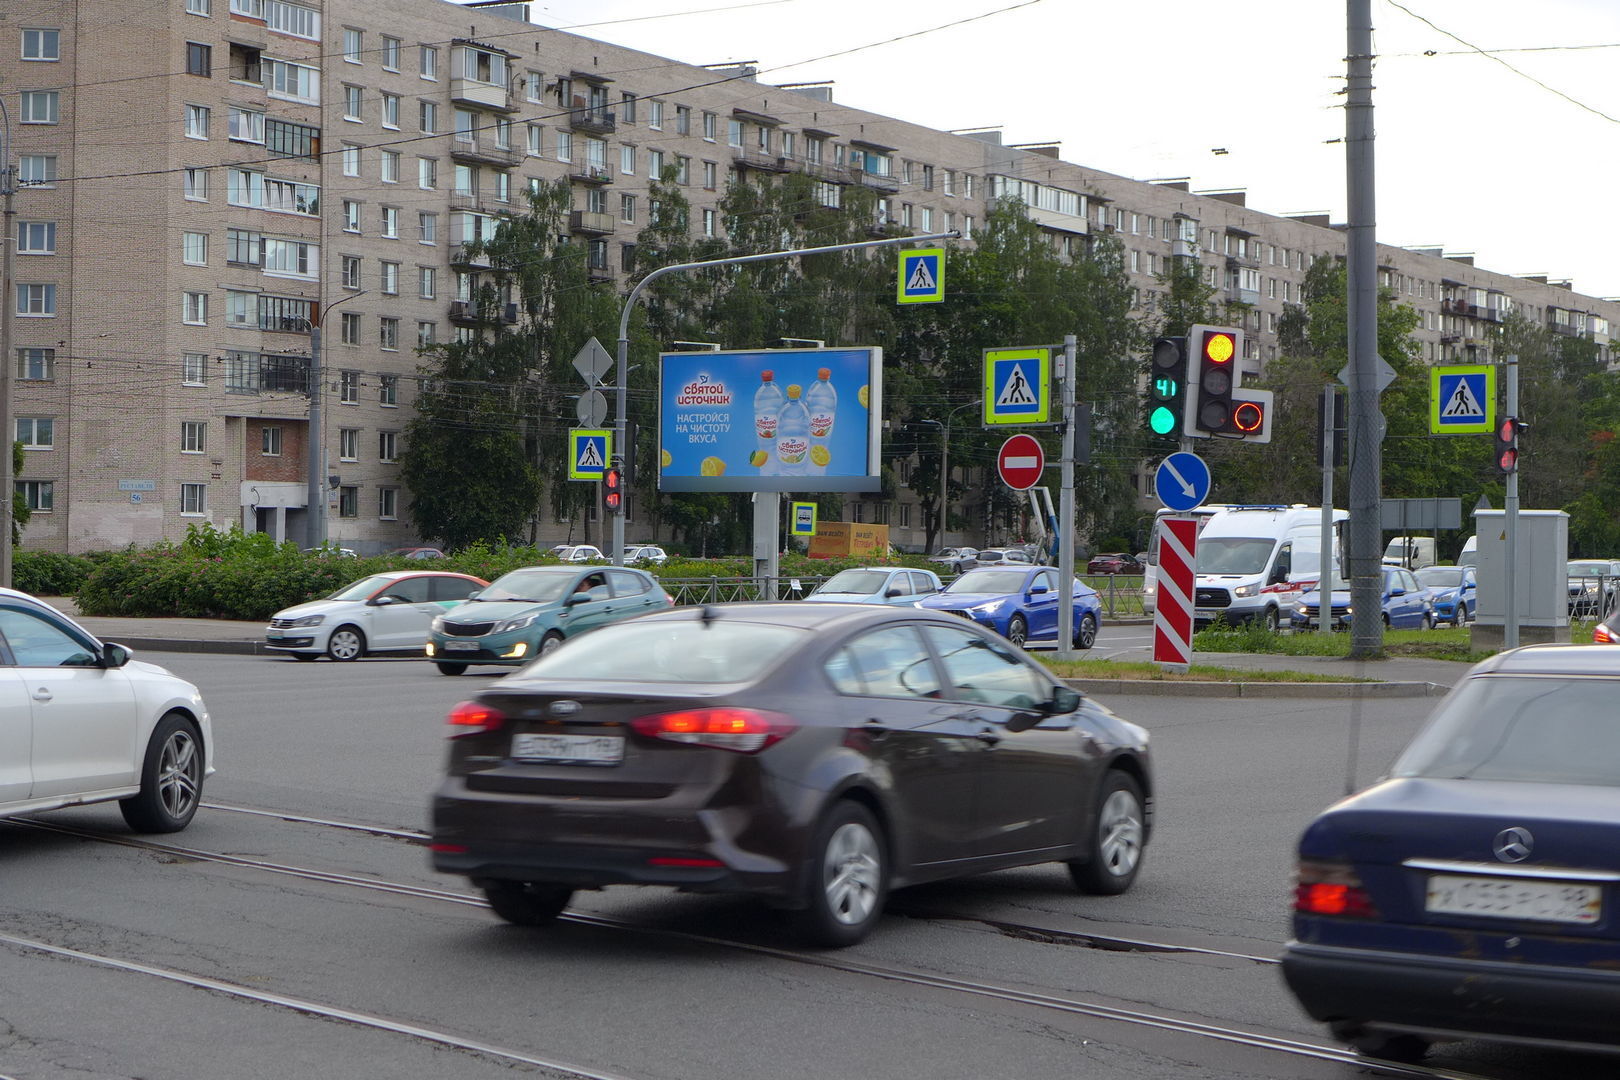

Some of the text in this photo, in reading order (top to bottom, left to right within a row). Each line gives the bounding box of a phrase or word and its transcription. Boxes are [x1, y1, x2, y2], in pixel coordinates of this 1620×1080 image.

[1156, 379, 1176, 397] 41
[676, 412, 729, 423] НАСТРОЙСЯ
[675, 423, 731, 433] НА ЧИСТОТУ
[688, 434, 718, 444] ВКУСА
[131, 494, 141, 502] 56
